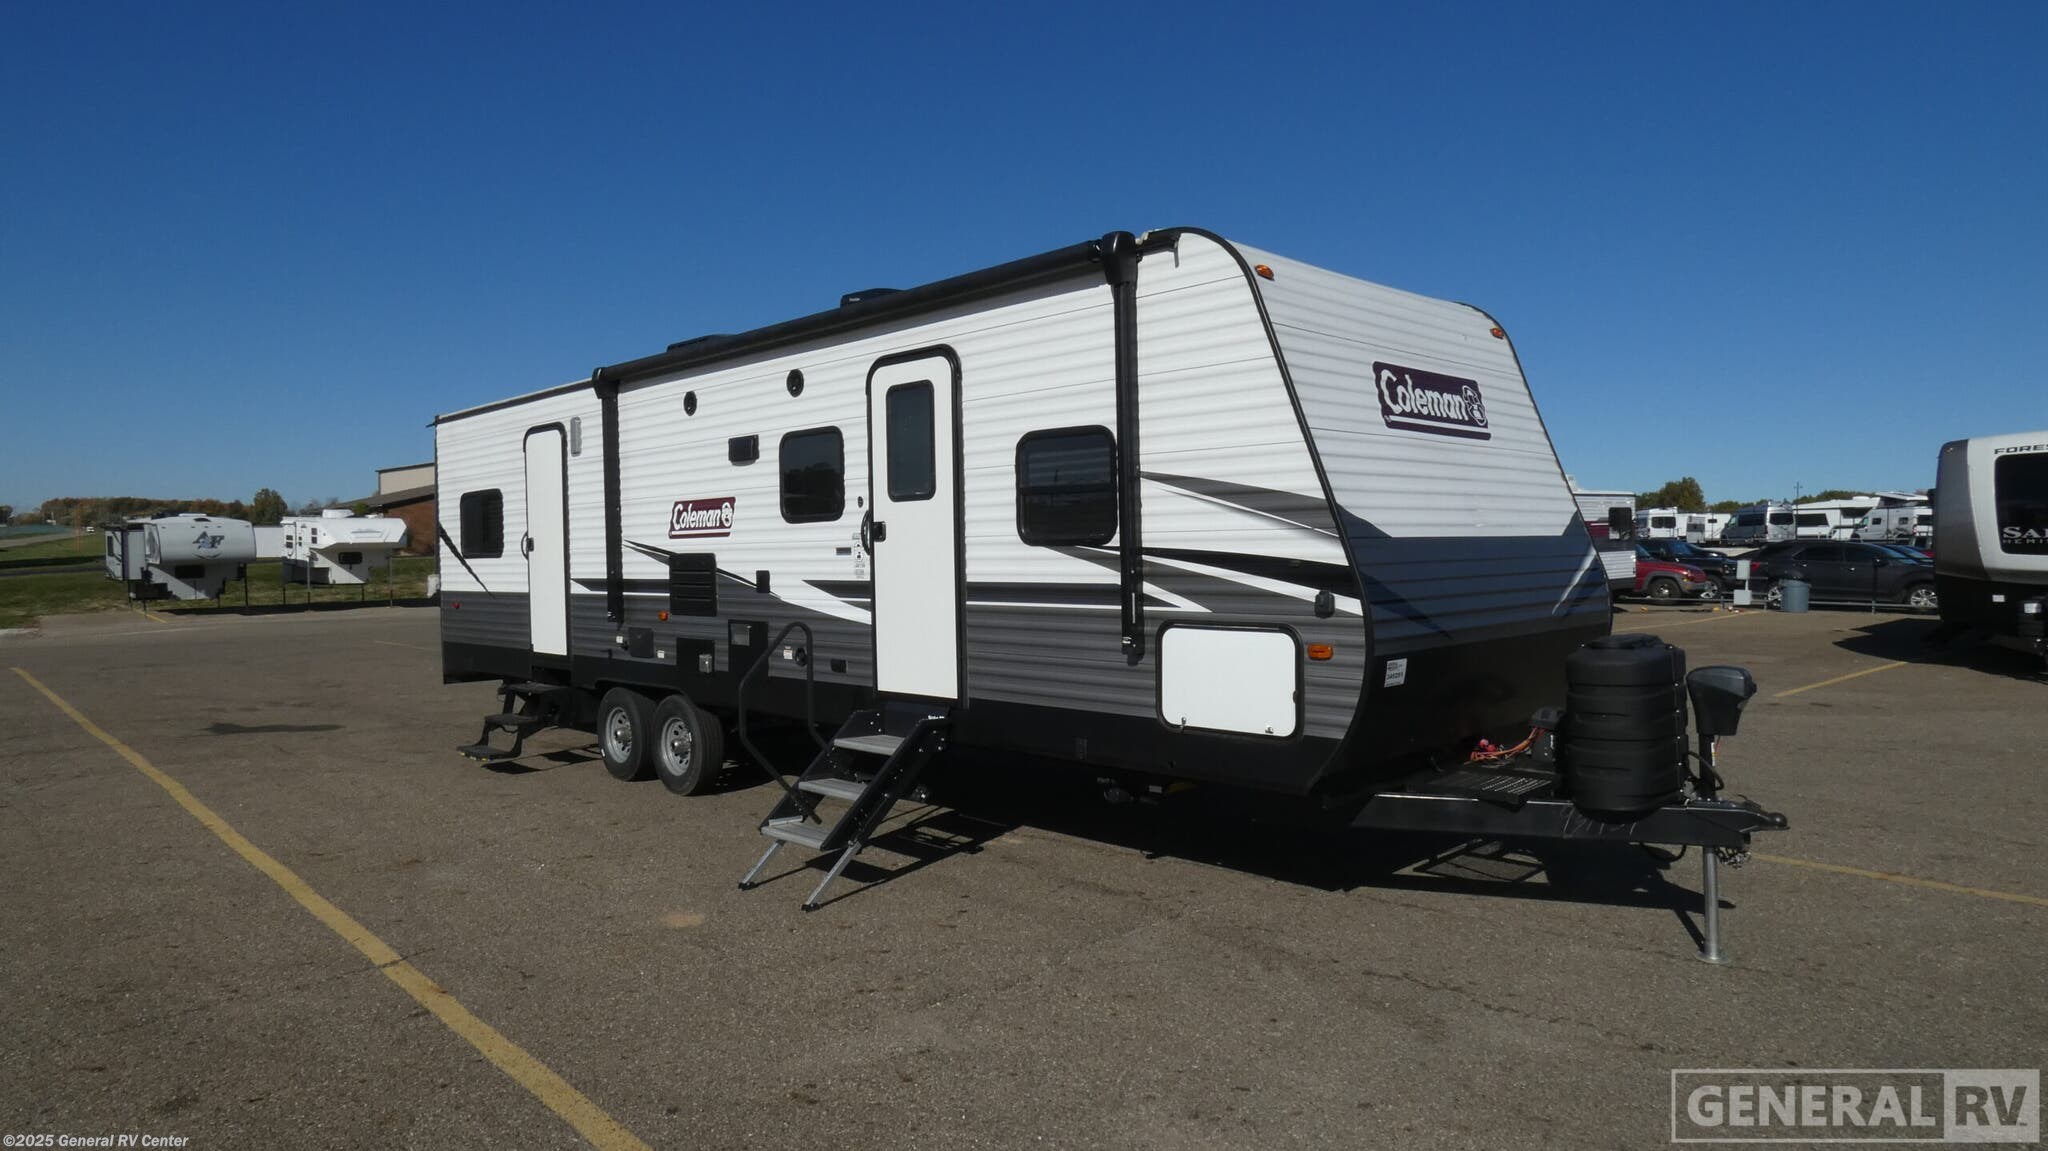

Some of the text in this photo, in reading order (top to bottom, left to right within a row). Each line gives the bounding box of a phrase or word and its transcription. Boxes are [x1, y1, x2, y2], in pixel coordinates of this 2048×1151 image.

[1380, 369, 1469, 421] Coleman
[1994, 444, 2048, 455] FORE
[673, 503, 722, 530] Coleman
